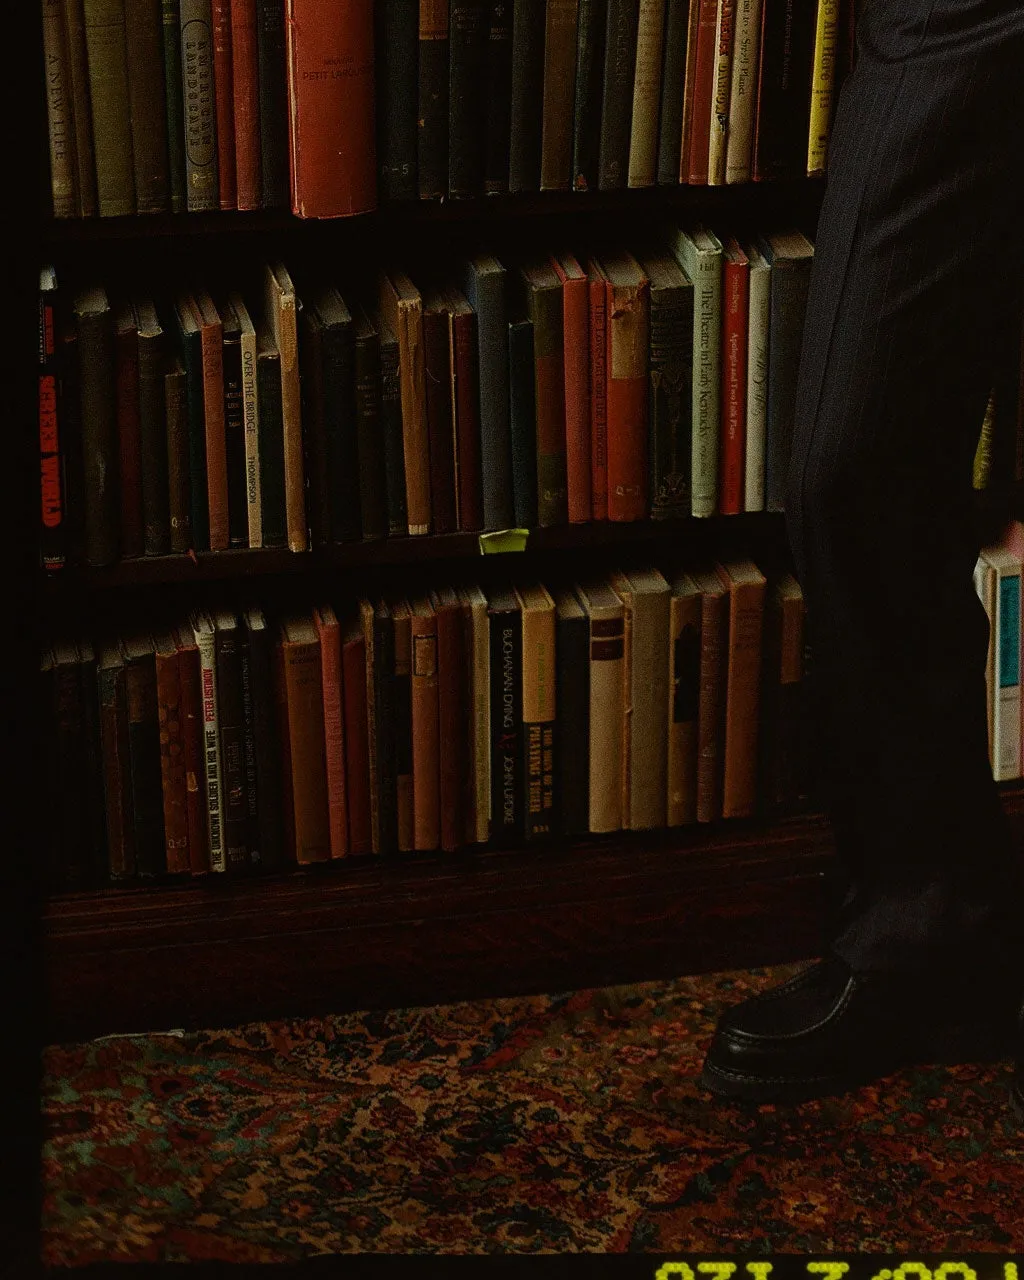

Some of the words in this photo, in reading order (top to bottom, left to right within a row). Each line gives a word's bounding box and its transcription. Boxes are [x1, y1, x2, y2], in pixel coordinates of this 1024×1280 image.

[747, 17, 752, 26] to
[822, 20, 836, 40] All
[48, 54, 56, 64] A
[820, 48, 834, 81] Here
[303, 70, 328, 80] PETIT
[741, 68, 750, 95] Planet
[49, 72, 64, 112] NEW
[186, 42, 200, 146] LANDSCAPE
[198, 41, 210, 145] AMERICAN
[54, 120, 66, 160] LIFE
[701, 290, 714, 308] The
[700, 311, 714, 348] Theatre
[700, 350, 712, 360] in
[731, 332, 740, 366] Apologia
[244, 351, 254, 377] OVER
[246, 380, 254, 398] THE
[247, 402, 256, 434] BRIDGE
[699, 391, 712, 438] Kentucky
[730, 419, 738, 440] Plays
[503, 628, 513, 691] BUCHANAN
[204, 668, 214, 698] USTINOV
[206, 700, 216, 722] PETER
[504, 694, 514, 728] DYING
[207, 730, 216, 748] WIFE
[208, 750, 216, 762] HIS
[208, 764, 218, 779] AND
[504, 756, 514, 786] JOHN
[210, 780, 219, 810] SOLDIER
[211, 812, 221, 850] UNKNOWN
[214, 852, 222, 866] THE
